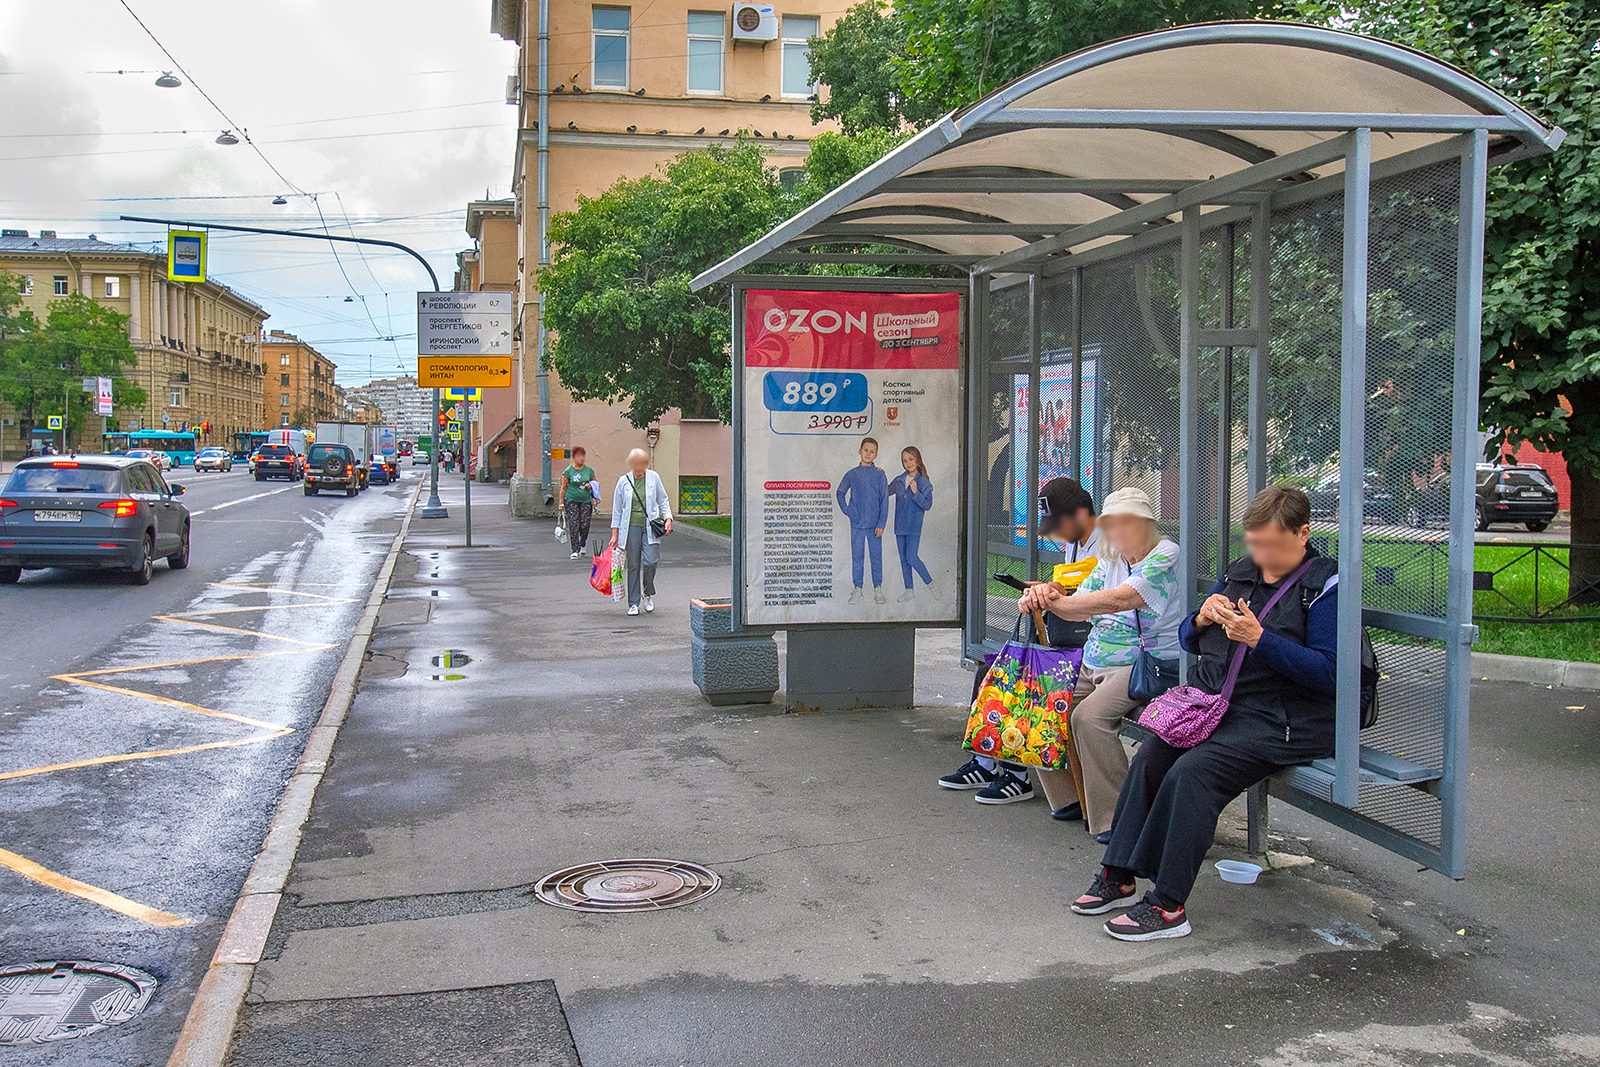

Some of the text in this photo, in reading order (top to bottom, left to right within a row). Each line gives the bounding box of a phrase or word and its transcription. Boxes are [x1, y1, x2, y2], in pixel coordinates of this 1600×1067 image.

[763, 308, 867, 334] OZON
[876, 314, 936, 328] Школьный
[877, 329, 908, 337] сезон
[901, 338, 938, 347] СЕНТЯБРЯ
[782, 381, 837, 406] 889
[882, 389, 925, 397] спортивный
